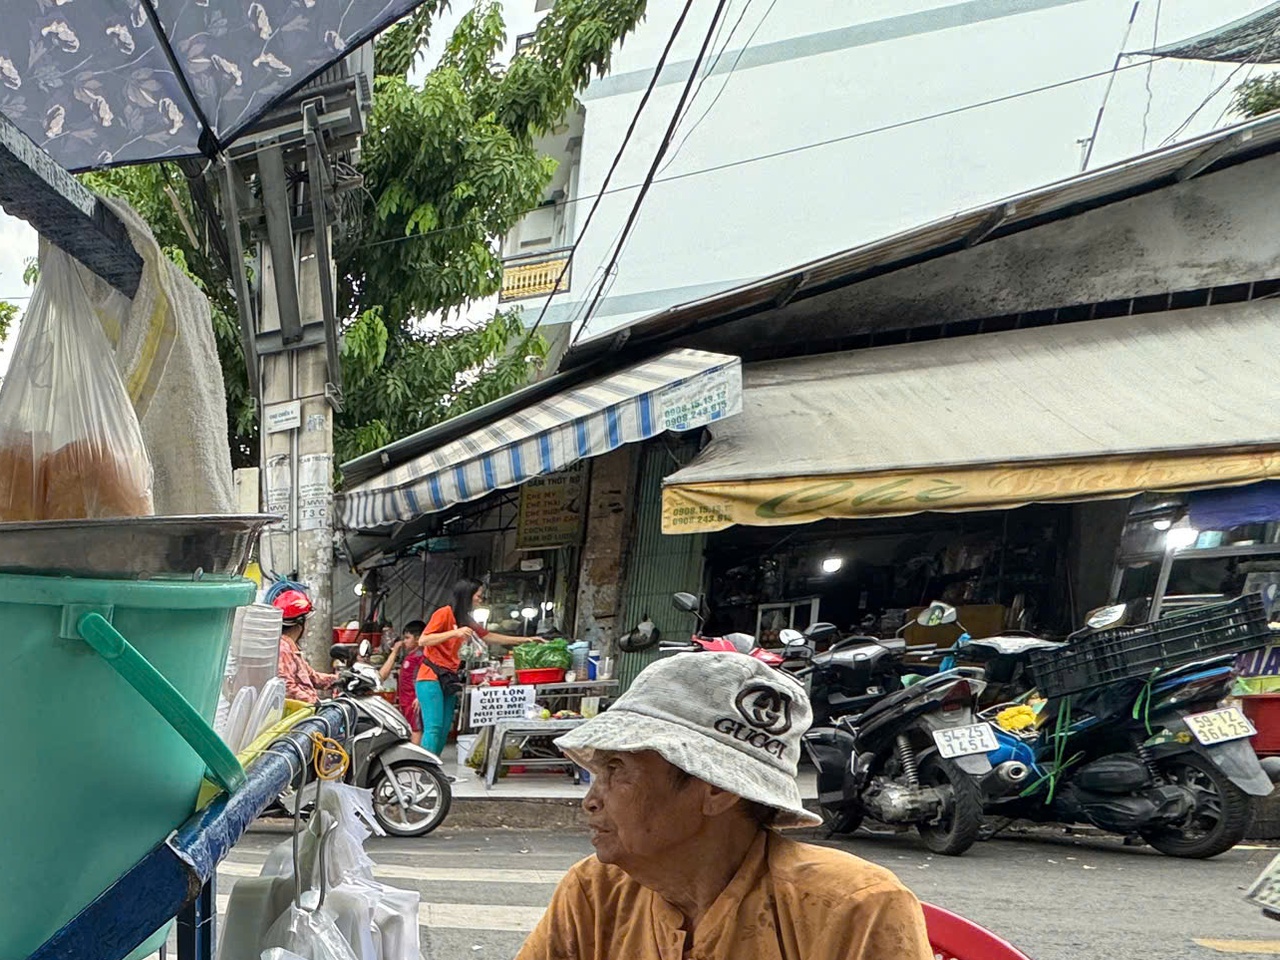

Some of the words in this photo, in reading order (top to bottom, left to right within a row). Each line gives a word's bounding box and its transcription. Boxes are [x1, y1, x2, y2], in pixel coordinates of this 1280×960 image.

[1193, 710, 1237, 728] 59-T2
[713, 717, 788, 760] GUCCI
[947, 738, 989, 754] 1454
